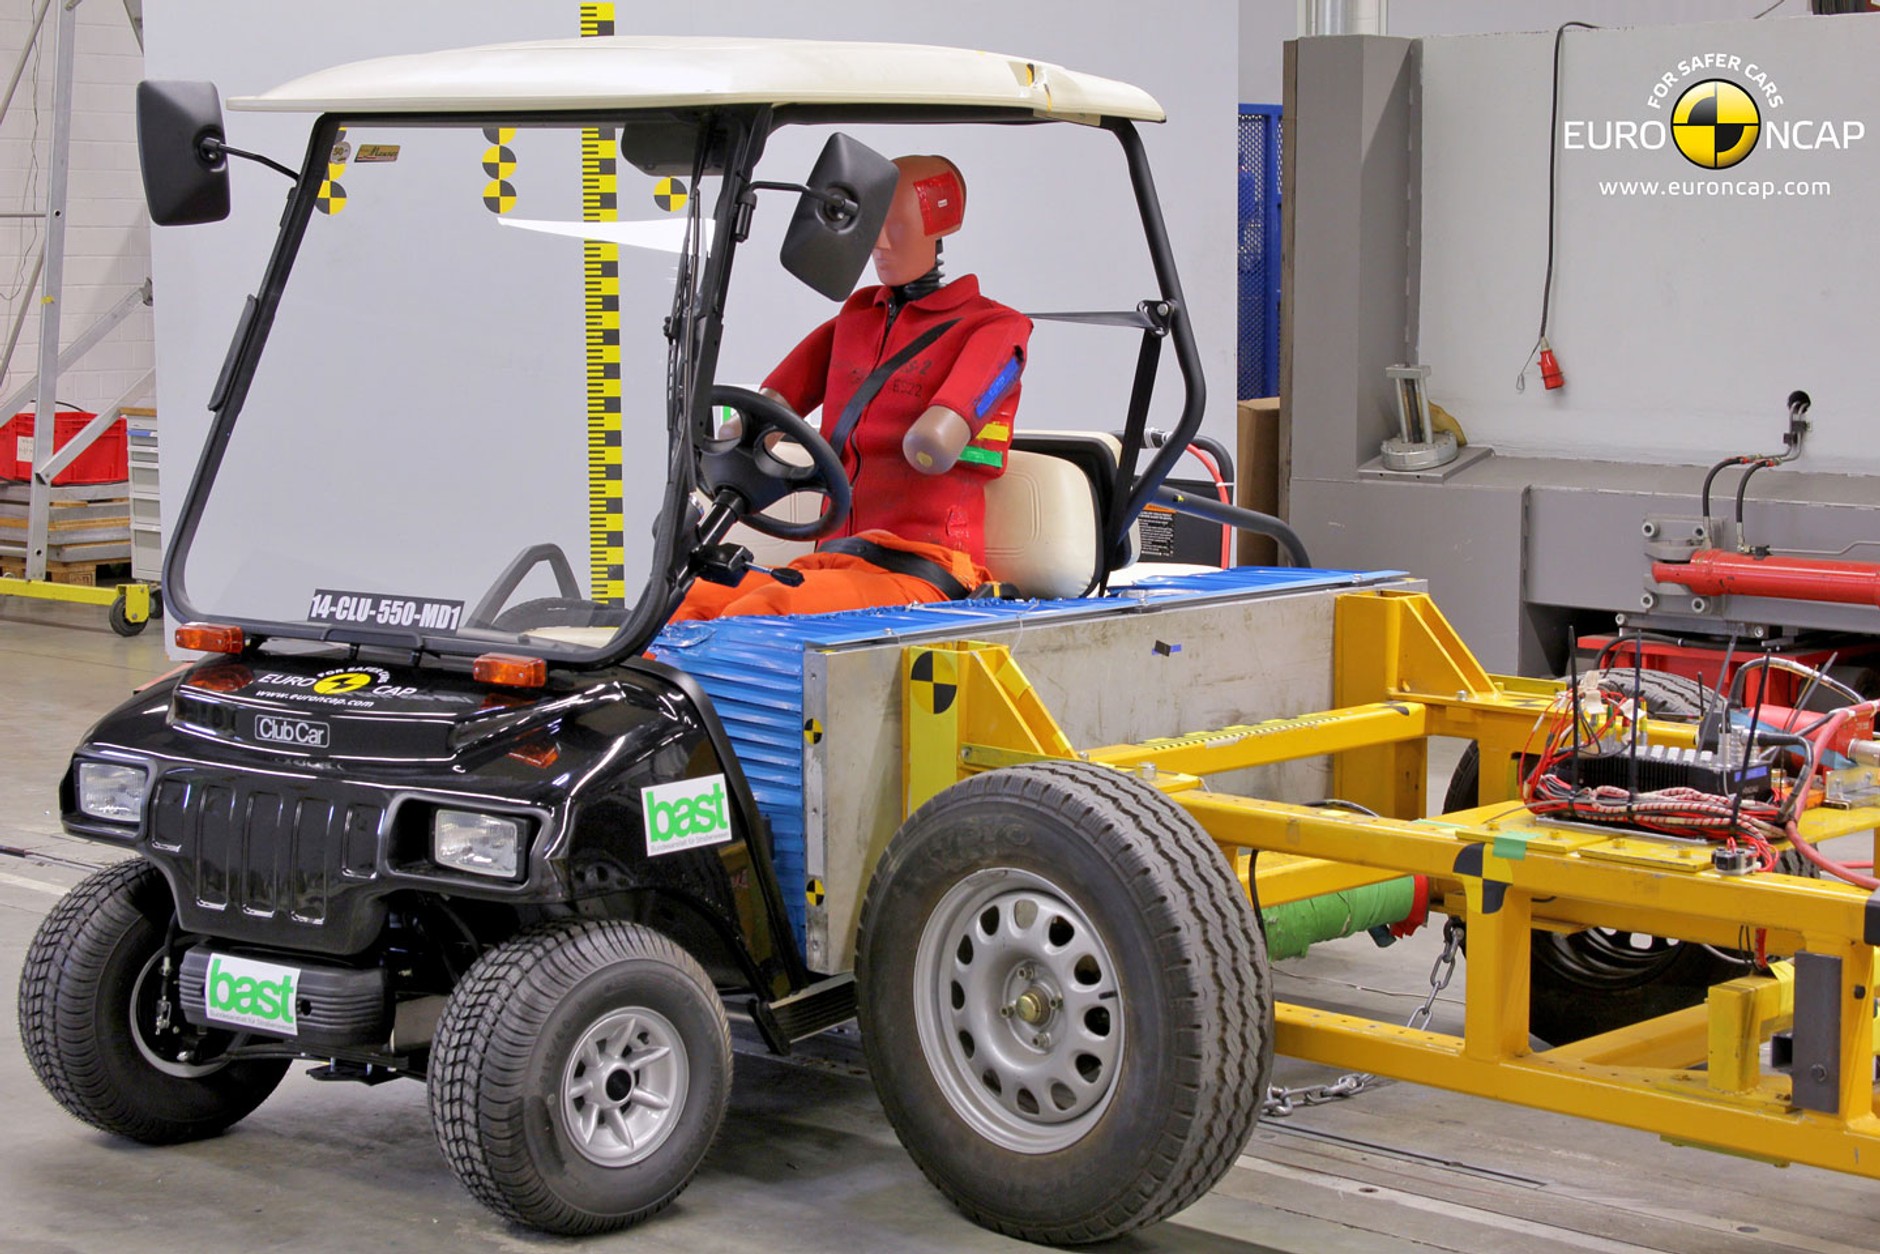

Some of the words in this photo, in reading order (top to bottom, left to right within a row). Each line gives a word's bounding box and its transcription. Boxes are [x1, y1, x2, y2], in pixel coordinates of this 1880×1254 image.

[310, 594, 462, 630] 14-CLU-550-MD1
[257, 673, 317, 687] EURO
[256, 689, 375, 708] www.euroncap.com
[259, 718, 293, 741] Club
[295, 722, 325, 745] Car
[646, 783, 728, 843] bast
[209, 959, 295, 1024] bast
